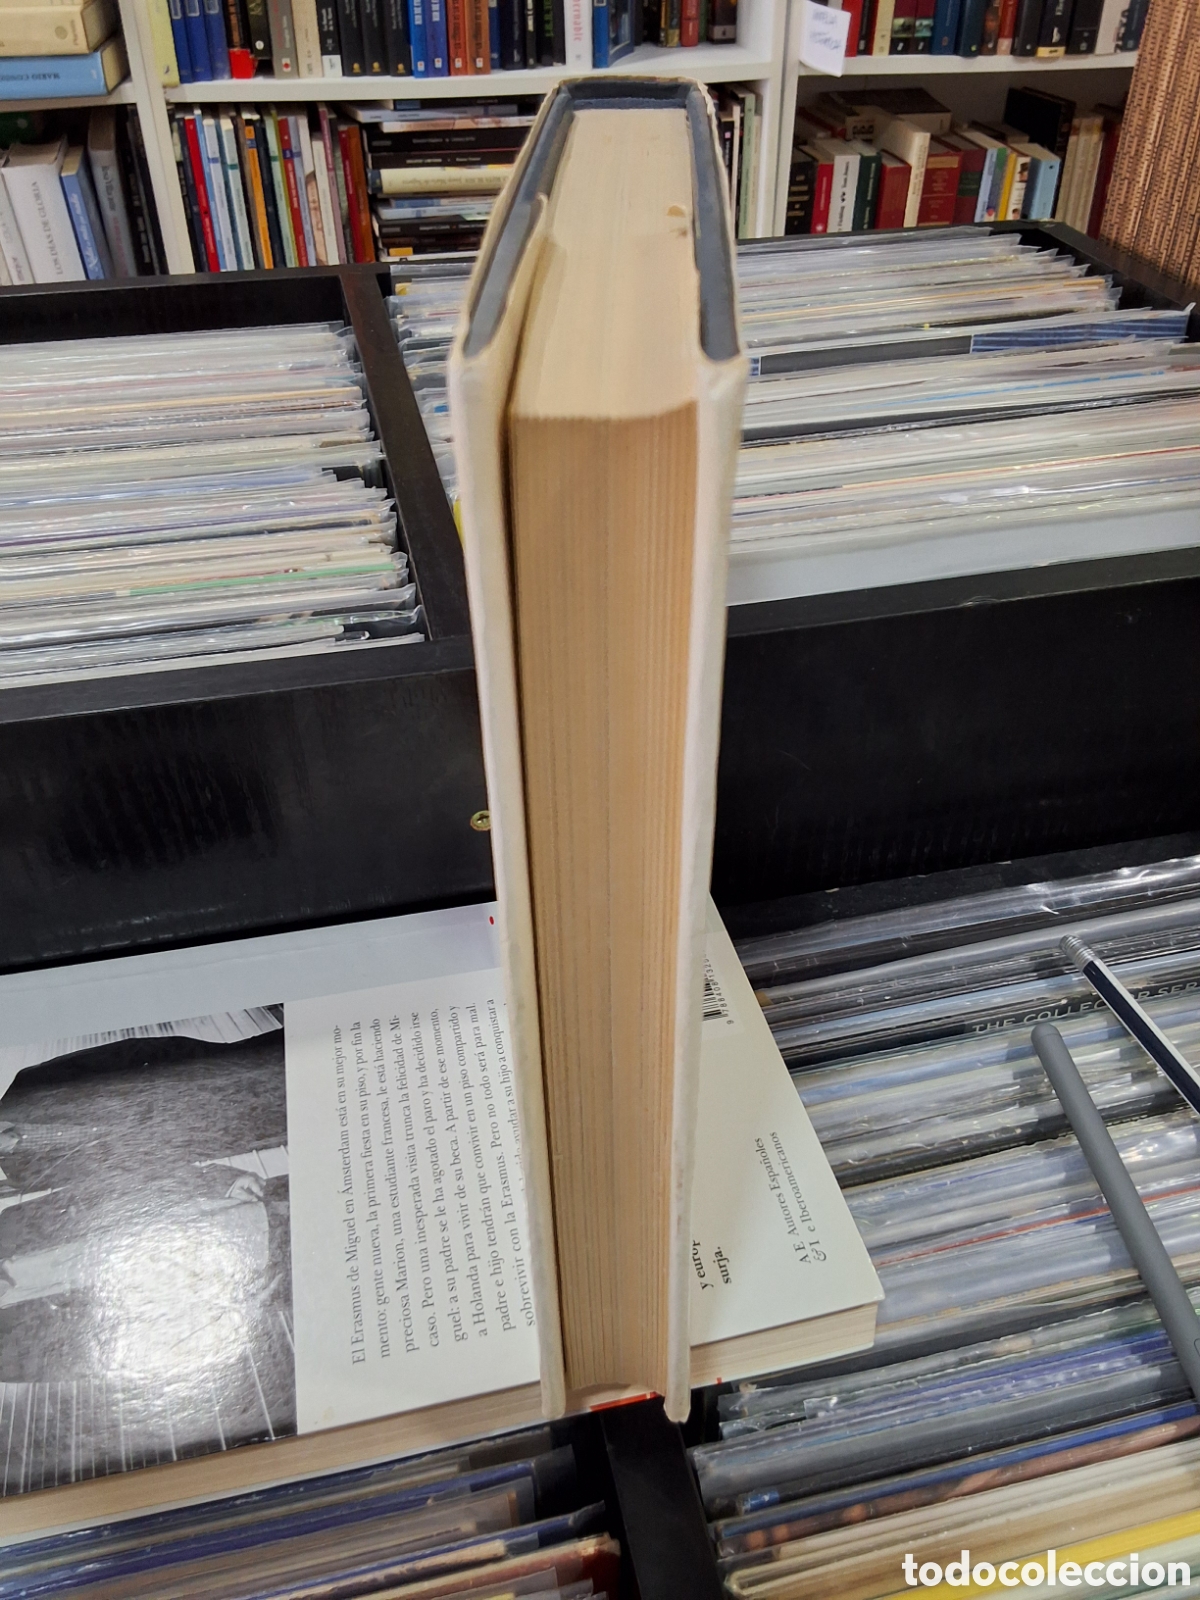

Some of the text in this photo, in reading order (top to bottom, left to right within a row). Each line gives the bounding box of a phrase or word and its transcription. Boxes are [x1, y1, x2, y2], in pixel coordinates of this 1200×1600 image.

[31, 181, 46, 218] GLORIA
[40, 219, 51, 232] DE
[53, 258, 64, 276] LOS
[409, 1012, 421, 1029] irse
[973, 1018, 1014, 1034] THE
[1024, 991, 1150, 1025] COLLECR
[349, 1021, 361, 1031] la
[350, 1031, 362, 1046] fin
[487, 1006, 505, 1055] conquistar
[410, 1030, 426, 1073] decidido
[447, 1012, 467, 1067] compartido
[355, 1048, 368, 1065] por
[498, 1055, 507, 1063] a
[355, 1073, 371, 1098] piso,
[417, 1074, 429, 1089] ha
[458, 1068, 474, 1090] piso
[497, 1063, 513, 1084] hijo
[463, 1091, 473, 1107] un
[504, 1085, 513, 1097] su
[359, 1099, 368, 1112] su
[422, 1097, 438, 1123] paro
[466, 1108, 476, 1123] en
[360, 1113, 370, 1127] en
[422, 1125, 435, 1136] el
[359, 1128, 373, 1158] fiesta
[466, 1126, 484, 1169] convivir
[424, 1137, 445, 1184] agotado
[430, 1008, 488, 1336] a Holanda para vivir de su beca. A partir de ese momento,
[465, 1002, 535, 1326] sobrevivir con la Erasmus. Pero no todo será para mal.
[363, 1160, 381, 1208] primera
[369, 1018, 420, 1353] preciosa Marion, una estudiante francesa, le está haciendo
[388, 1014, 439, 1347] caso. Pero una inesperada visita trunca la felicidad de Mi-
[477, 1172, 492, 1194] que
[769, 1131, 812, 1223] Iberoamericanos
[332, 1024, 366, 1365] El Erasmus de Miguel en Ámsterdam está en su mejor mo-
[432, 1186, 445, 1203] ha
[754, 1137, 811, 1263] A E Autores Españoles
[365, 1210, 378, 1222] la
[434, 1205, 446, 1218] le
[478, 1196, 497, 1247] tendrán
[438, 1220, 448, 1233] se
[370, 1223, 382, 1266] nueva,
[438, 1235, 459, 1274] padre
[487, 1249, 505, 1277] hijo
[713, 1246, 732, 1284] surja.
[373, 1269, 390, 1306] gente
[446, 1276, 457, 1292] su
[494, 1279, 504, 1287] e
[700, 1281, 715, 1290] y
[449, 1294, 459, 1304] a
[495, 1290, 516, 1332] padre
[377, 1308, 390, 1358] mento:
[447, 1306, 468, 1342] guel:
